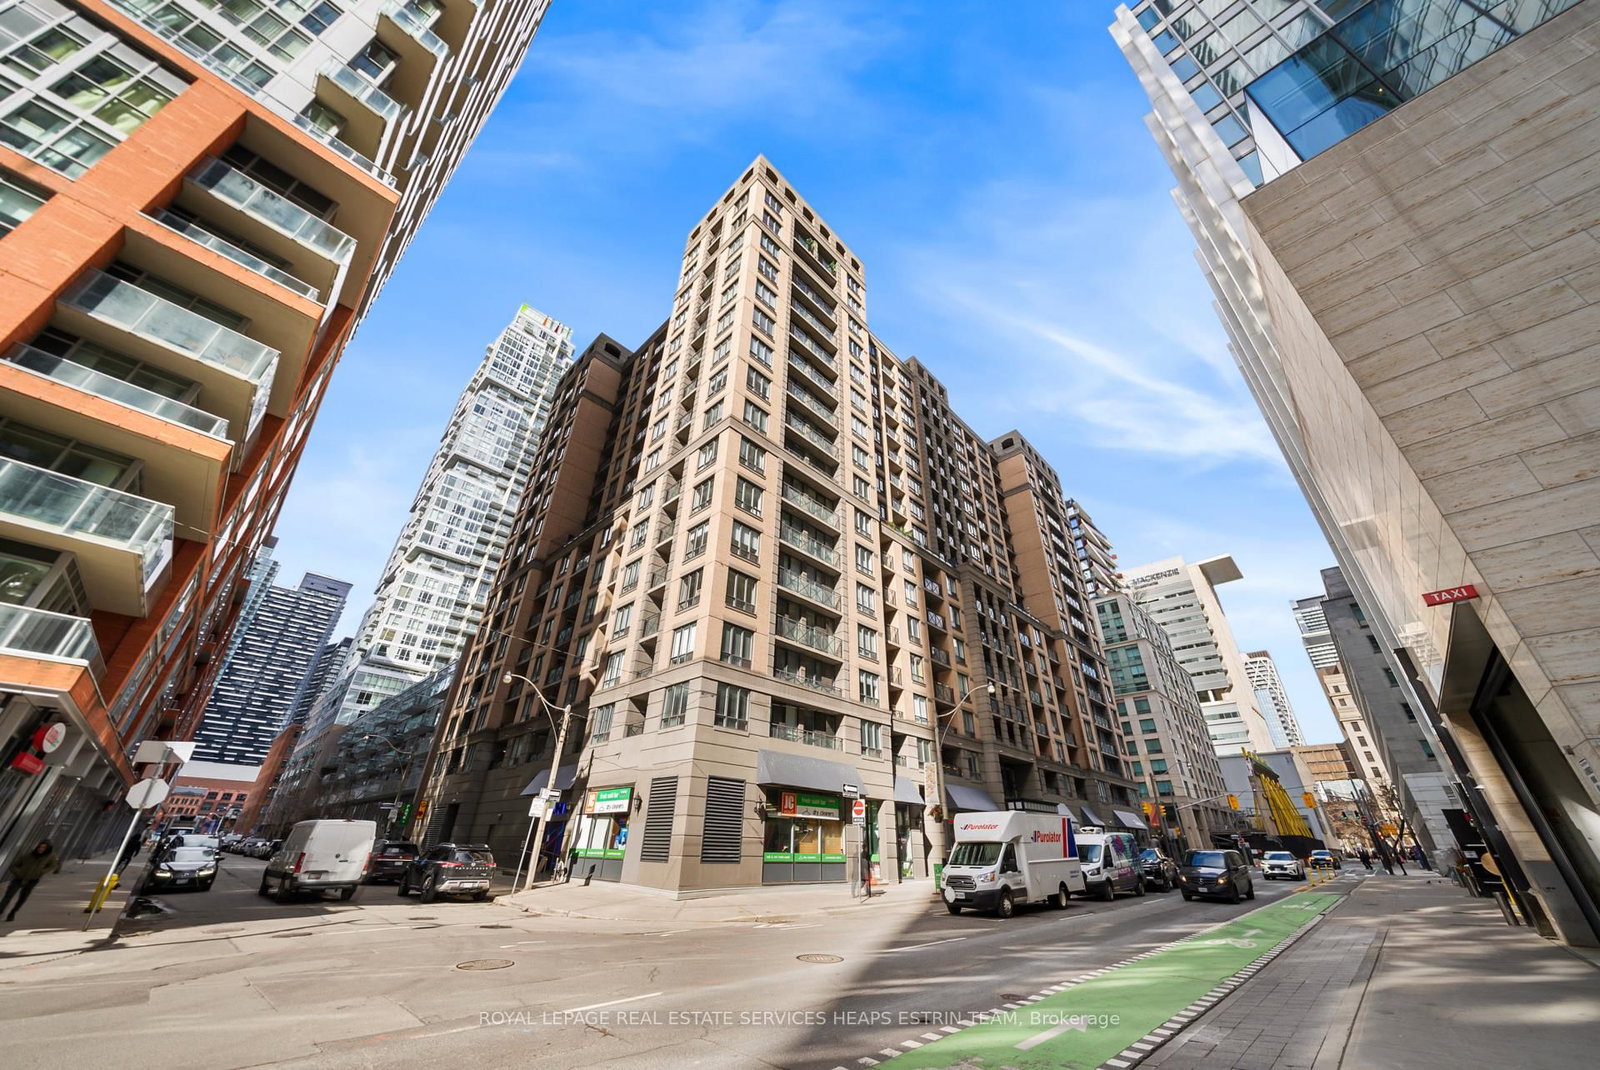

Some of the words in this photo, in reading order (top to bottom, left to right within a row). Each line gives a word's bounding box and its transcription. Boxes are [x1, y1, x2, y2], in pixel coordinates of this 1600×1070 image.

[1431, 588, 1467, 601] TAXI
[966, 823, 999, 831] Purolator
[1035, 830, 1062, 843] Purolator
